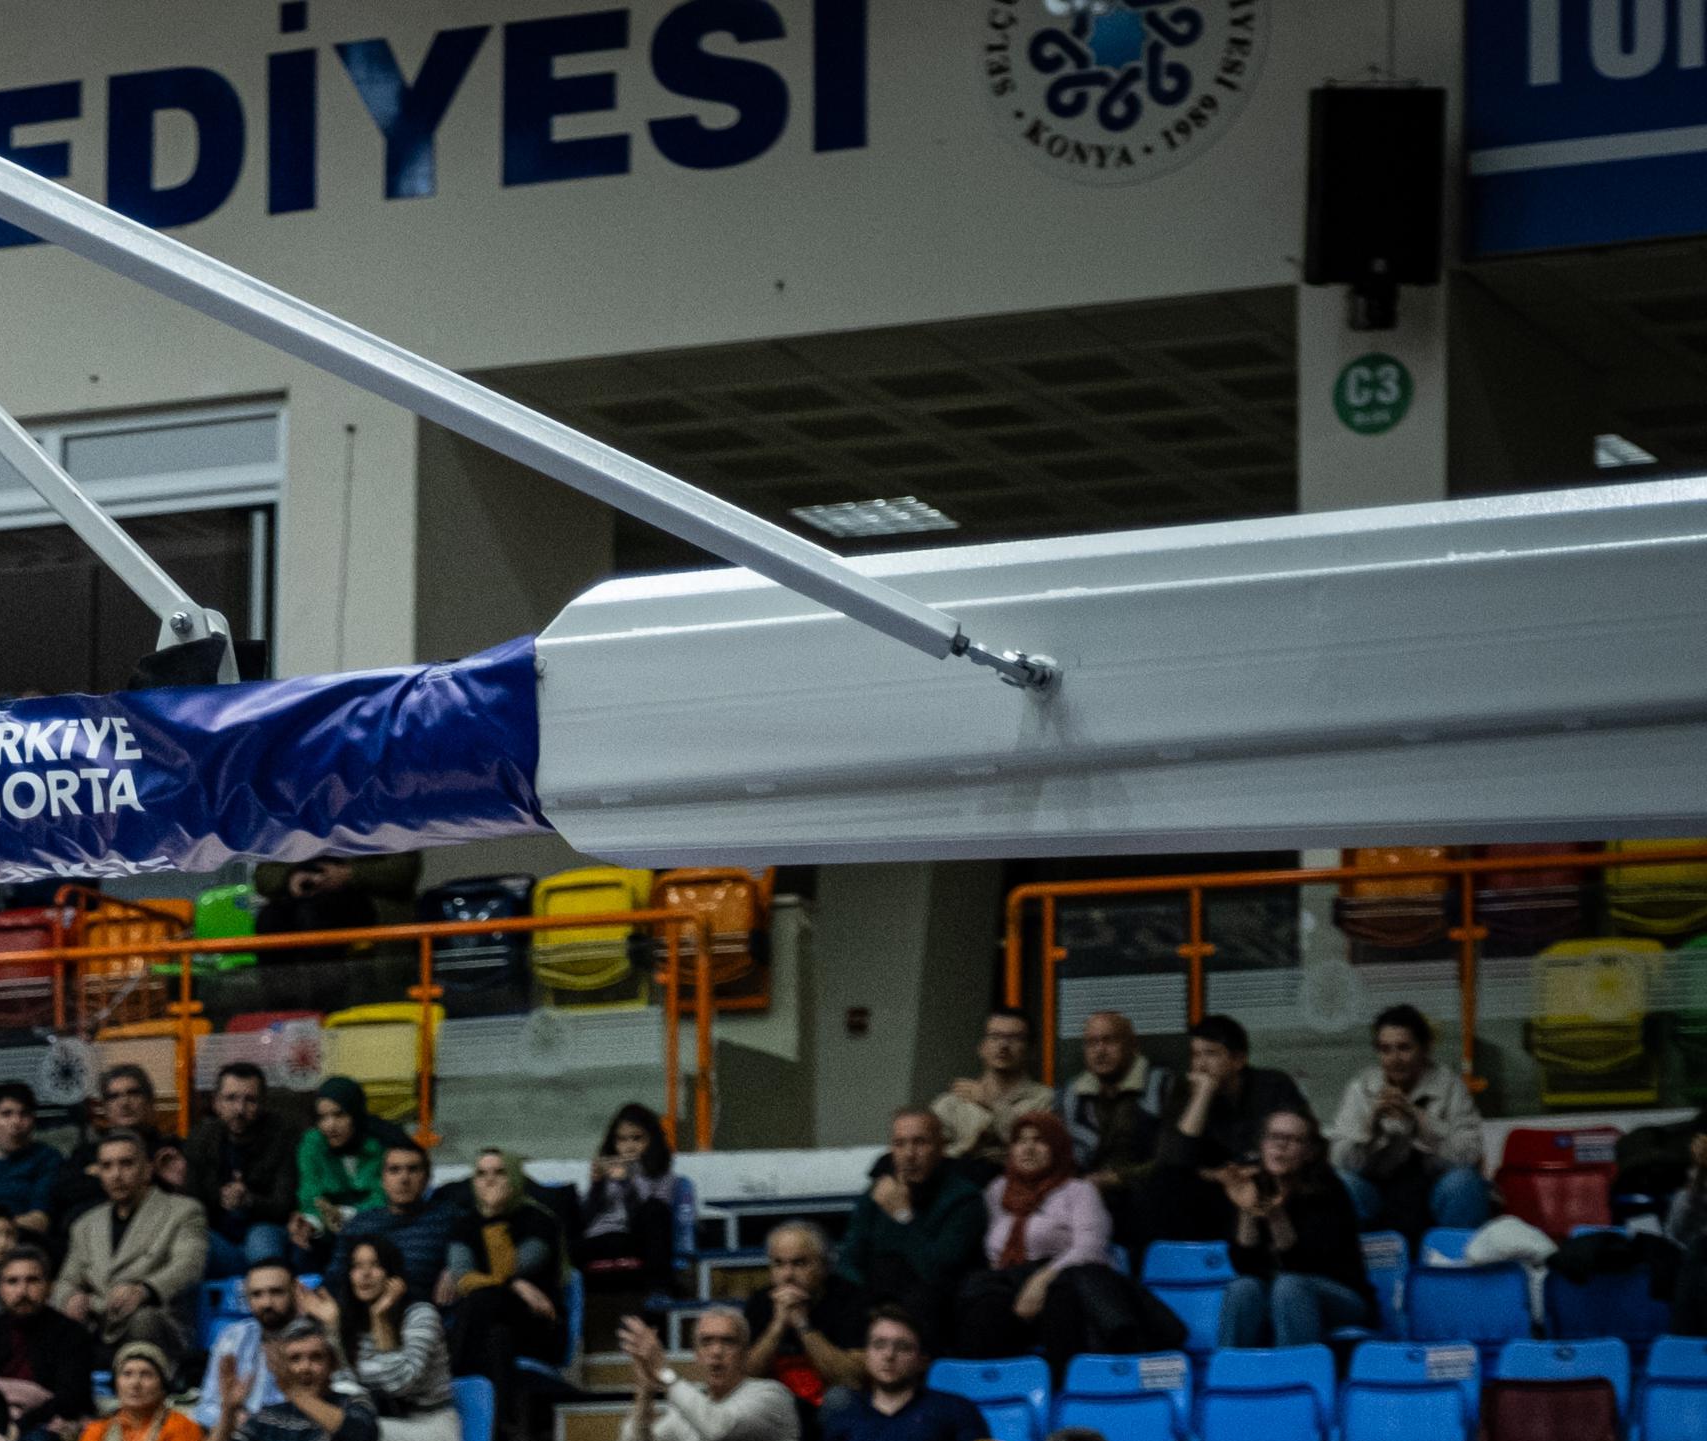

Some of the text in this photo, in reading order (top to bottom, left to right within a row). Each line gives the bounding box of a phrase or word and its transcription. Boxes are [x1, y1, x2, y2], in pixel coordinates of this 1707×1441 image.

[1021, 94, 1218, 169] KONYA 1989
[1345, 364, 1401, 406] C3
